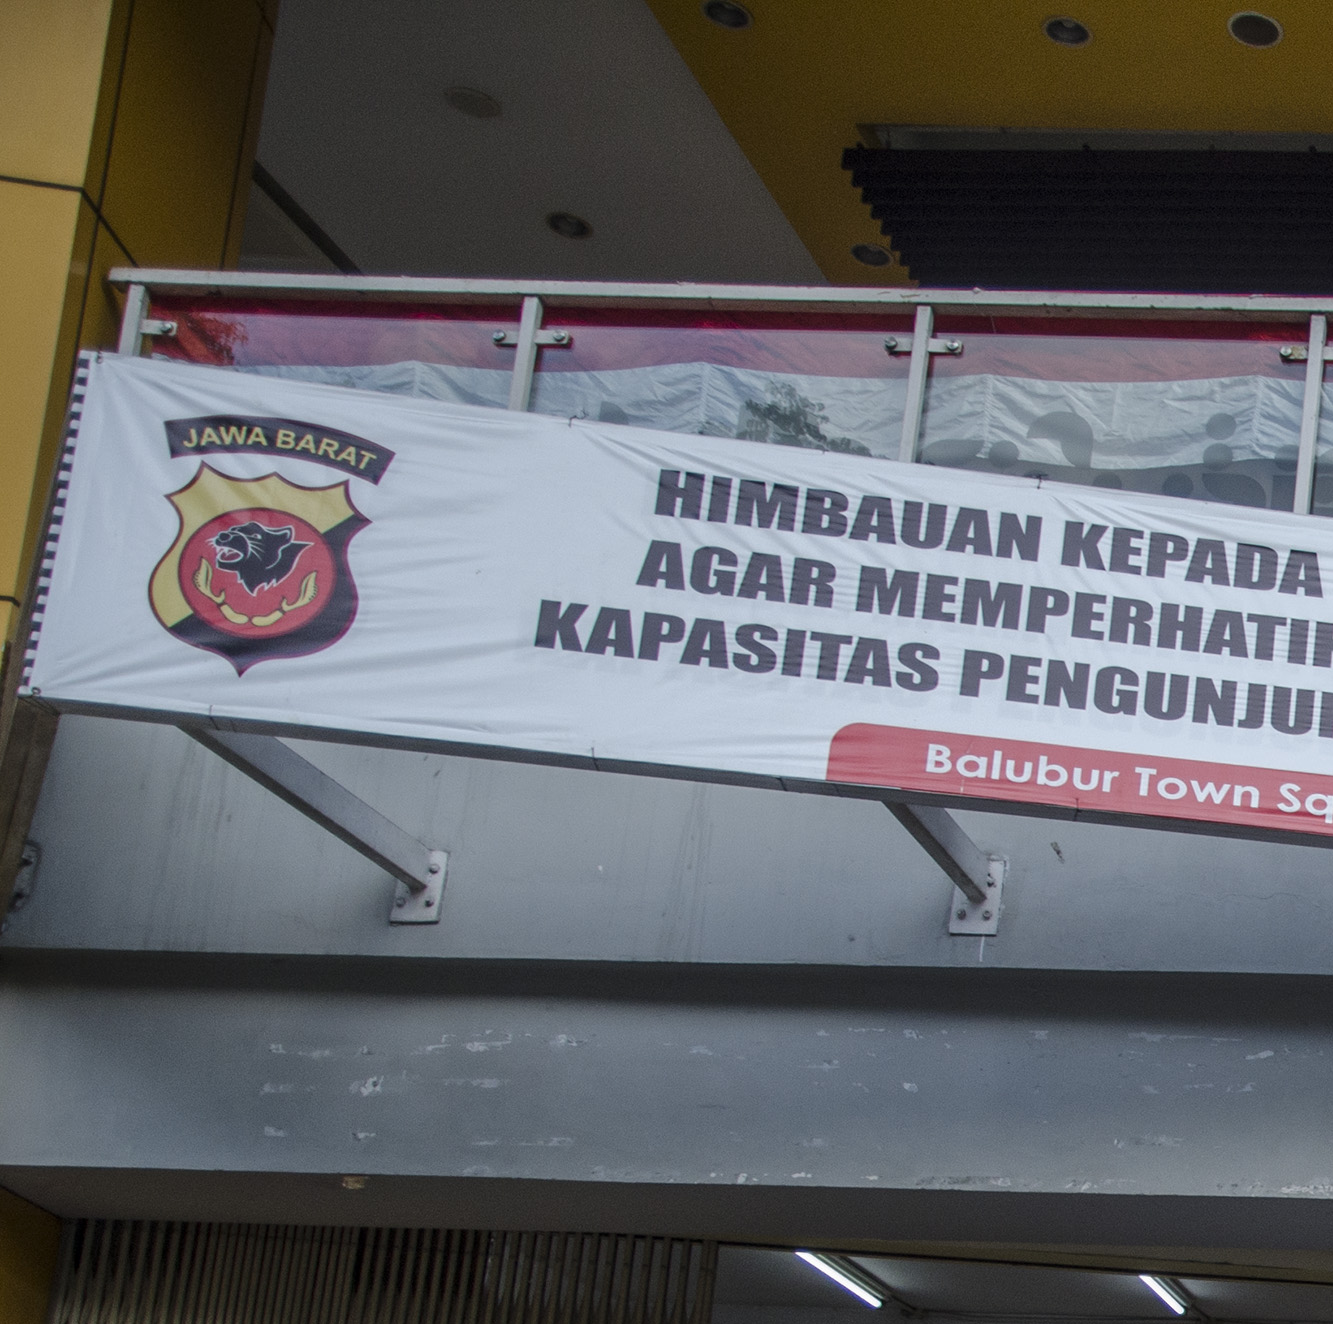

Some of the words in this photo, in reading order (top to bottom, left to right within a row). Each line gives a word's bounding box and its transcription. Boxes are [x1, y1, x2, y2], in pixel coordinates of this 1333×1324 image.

[183, 426, 268, 448] JAWA
[275, 429, 378, 470] BARAT
[654, 468, 1042, 562] HIMBAUAN
[1060, 520, 1323, 598] KEPADA
[636, 540, 837, 608] AGAR
[534, 599, 940, 692] KAPASITAS
[925, 743, 1119, 793] Balubur
[1134, 766, 1260, 809] Town
